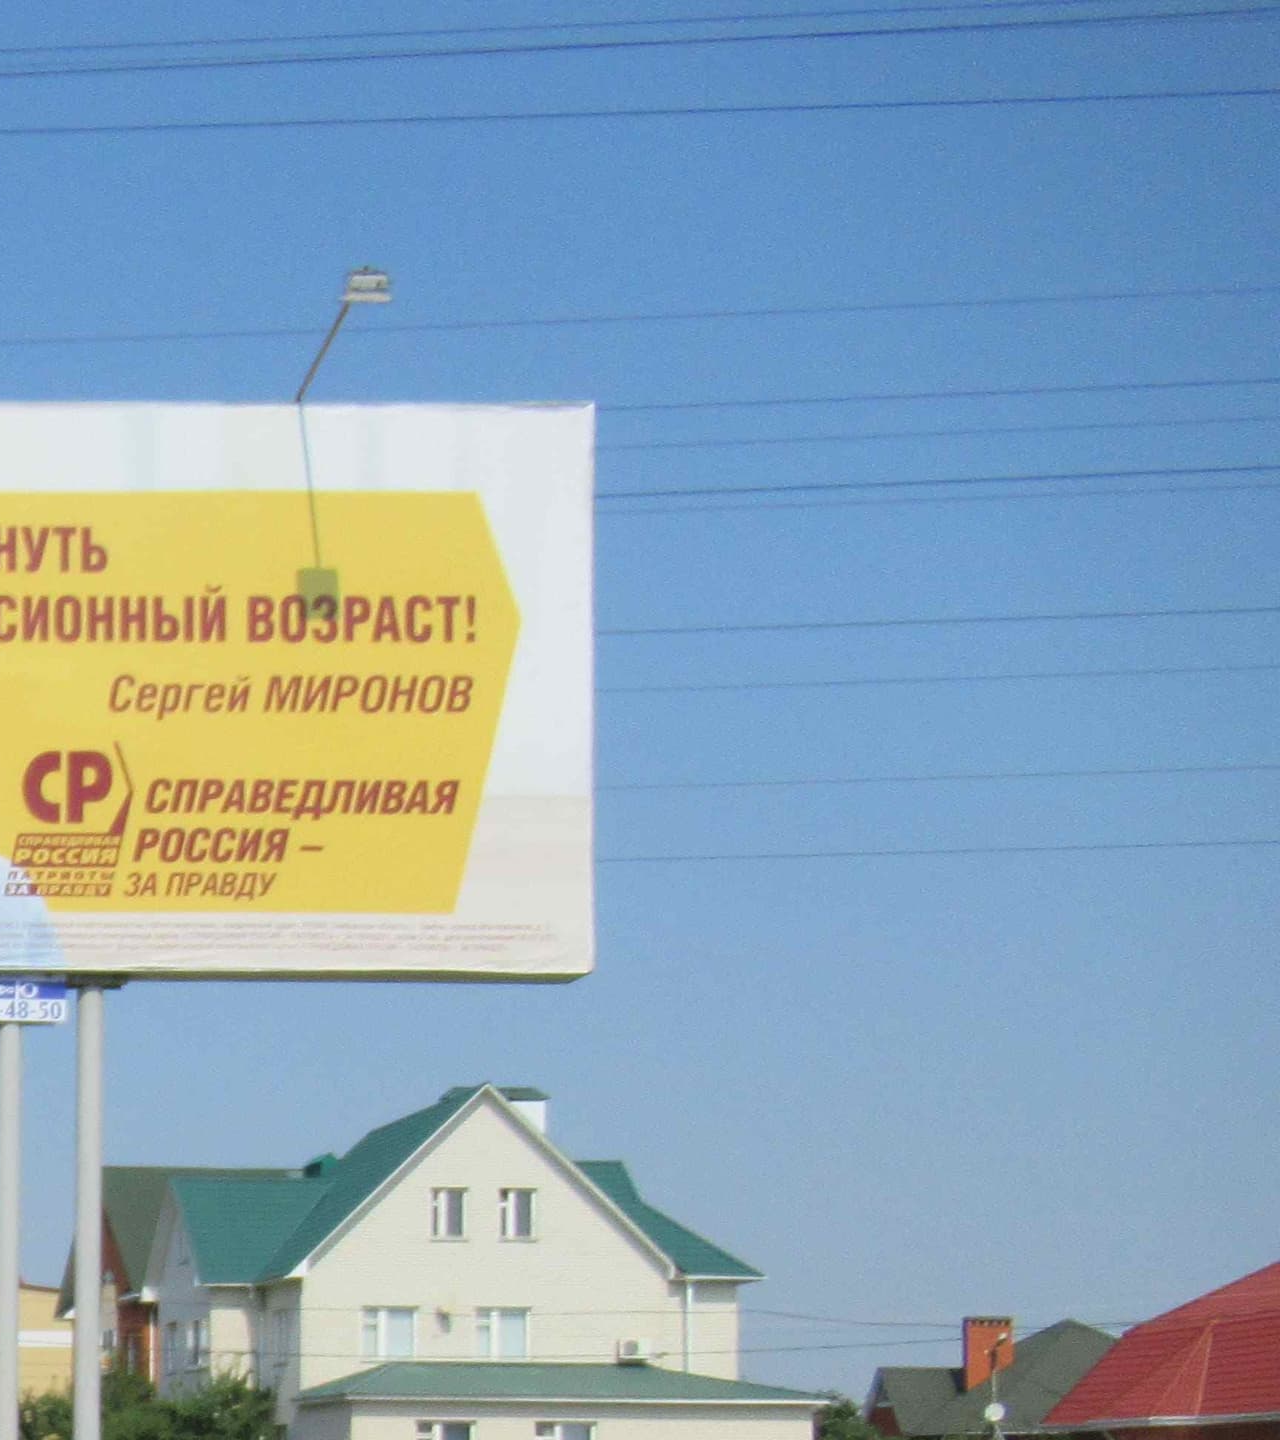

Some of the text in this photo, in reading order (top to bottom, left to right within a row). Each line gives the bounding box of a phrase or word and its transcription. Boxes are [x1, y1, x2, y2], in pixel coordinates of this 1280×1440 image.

[246, 595, 478, 644] ВОЗРАСТ!
[108, 675, 475, 720] Сергей МИРОНОВ
[21, 750, 113, 824] СР
[144, 779, 460, 820] СПРАВЕДЛИВАЯ
[13, 848, 119, 866] РОССИЯ
[132, 828, 287, 864] РОССИЯ
[123, 872, 277, 899] ЗА ПРАВДУ
